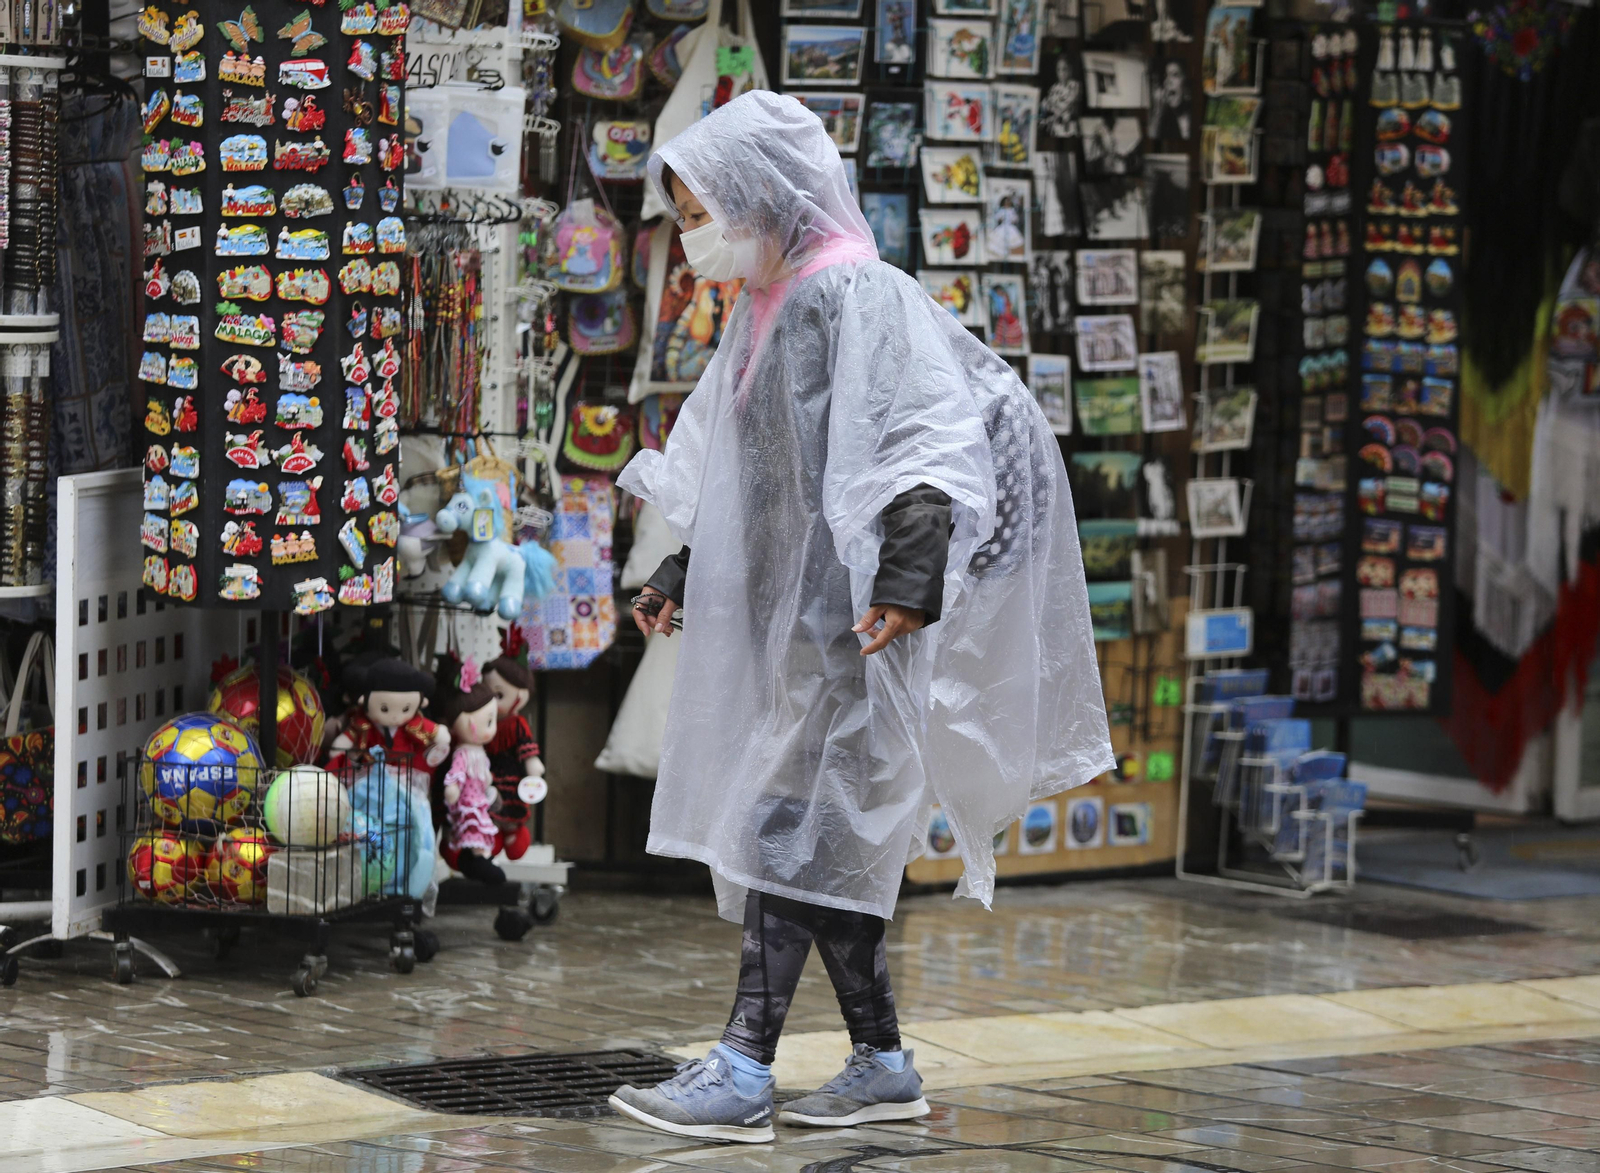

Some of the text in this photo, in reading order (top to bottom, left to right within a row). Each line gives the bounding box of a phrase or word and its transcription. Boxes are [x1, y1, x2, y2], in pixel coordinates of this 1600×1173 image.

[218, 73, 265, 88] MALAGA
[217, 324, 272, 341] MALAGA
[161, 766, 234, 789] ESPAÑA
